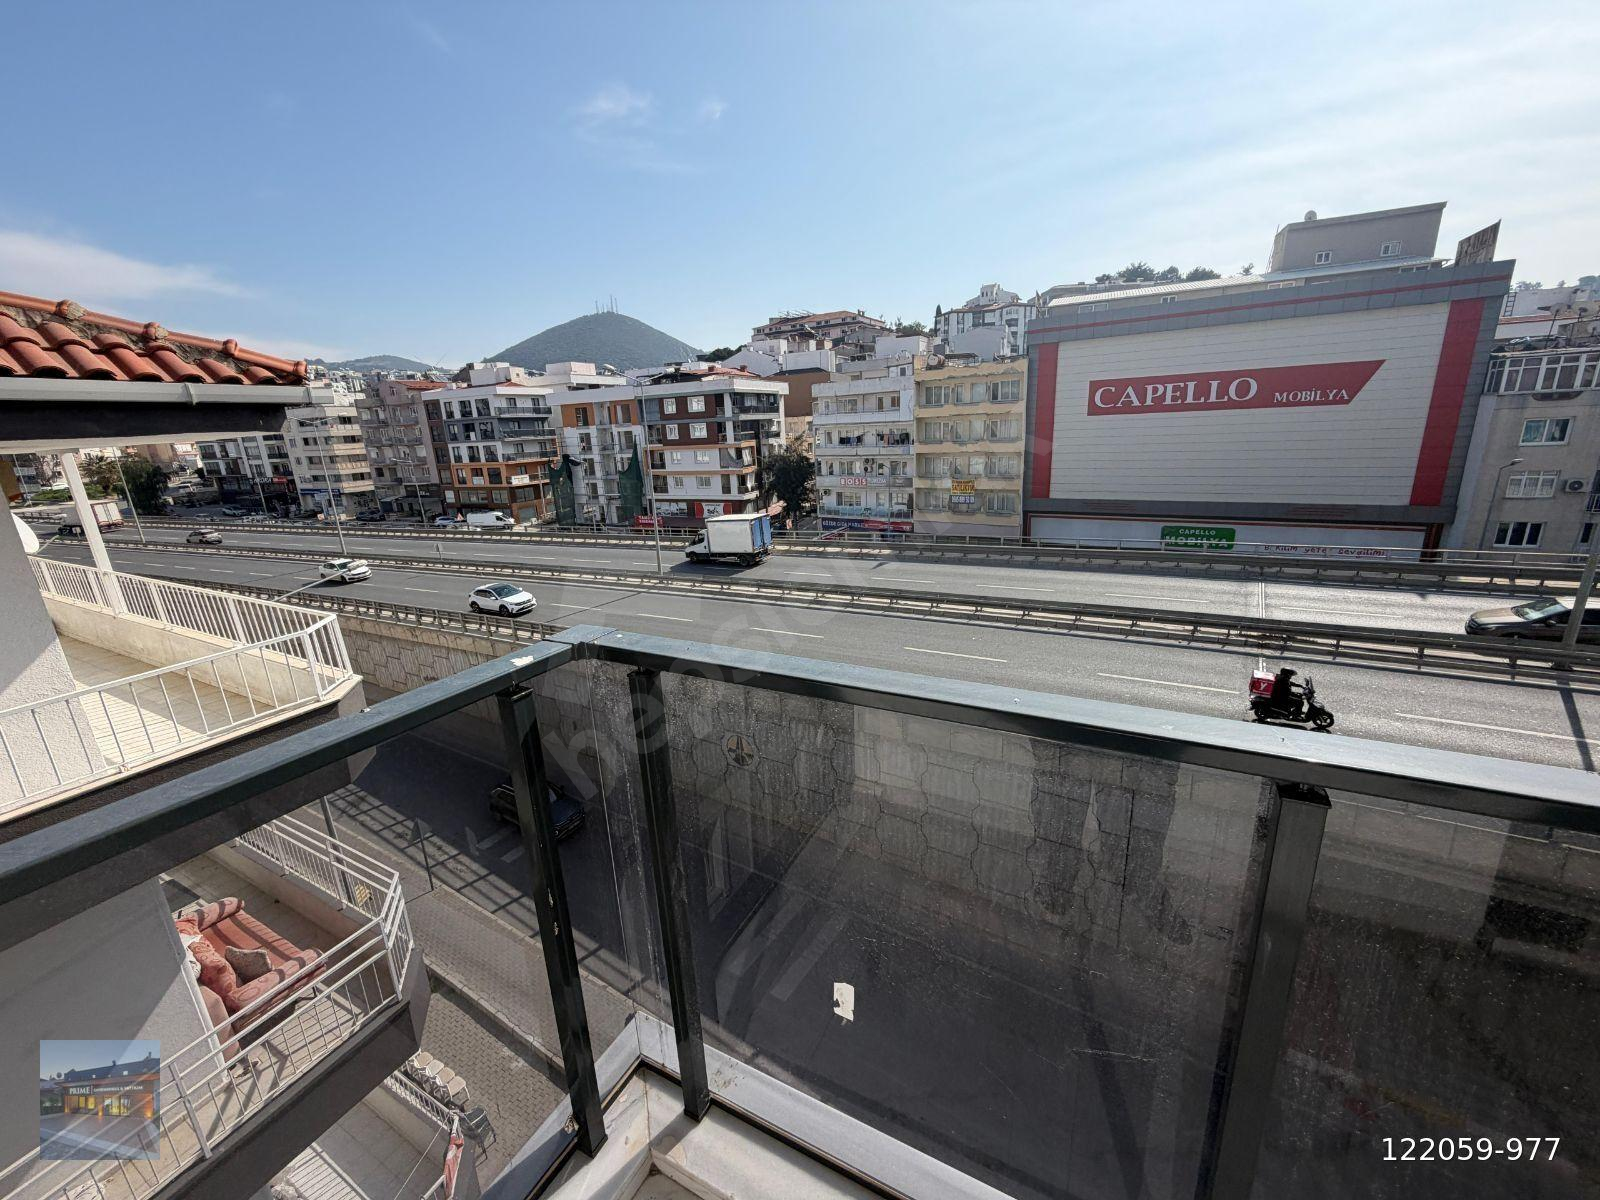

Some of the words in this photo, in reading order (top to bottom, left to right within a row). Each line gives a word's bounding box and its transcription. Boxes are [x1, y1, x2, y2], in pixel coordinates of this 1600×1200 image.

[1094, 377, 1258, 408] CAPELLO
[1274, 388, 1350, 403] MOBİLYA
[840, 477, 867, 486] BOSS
[1179, 528, 1216, 536] CAPELLO
